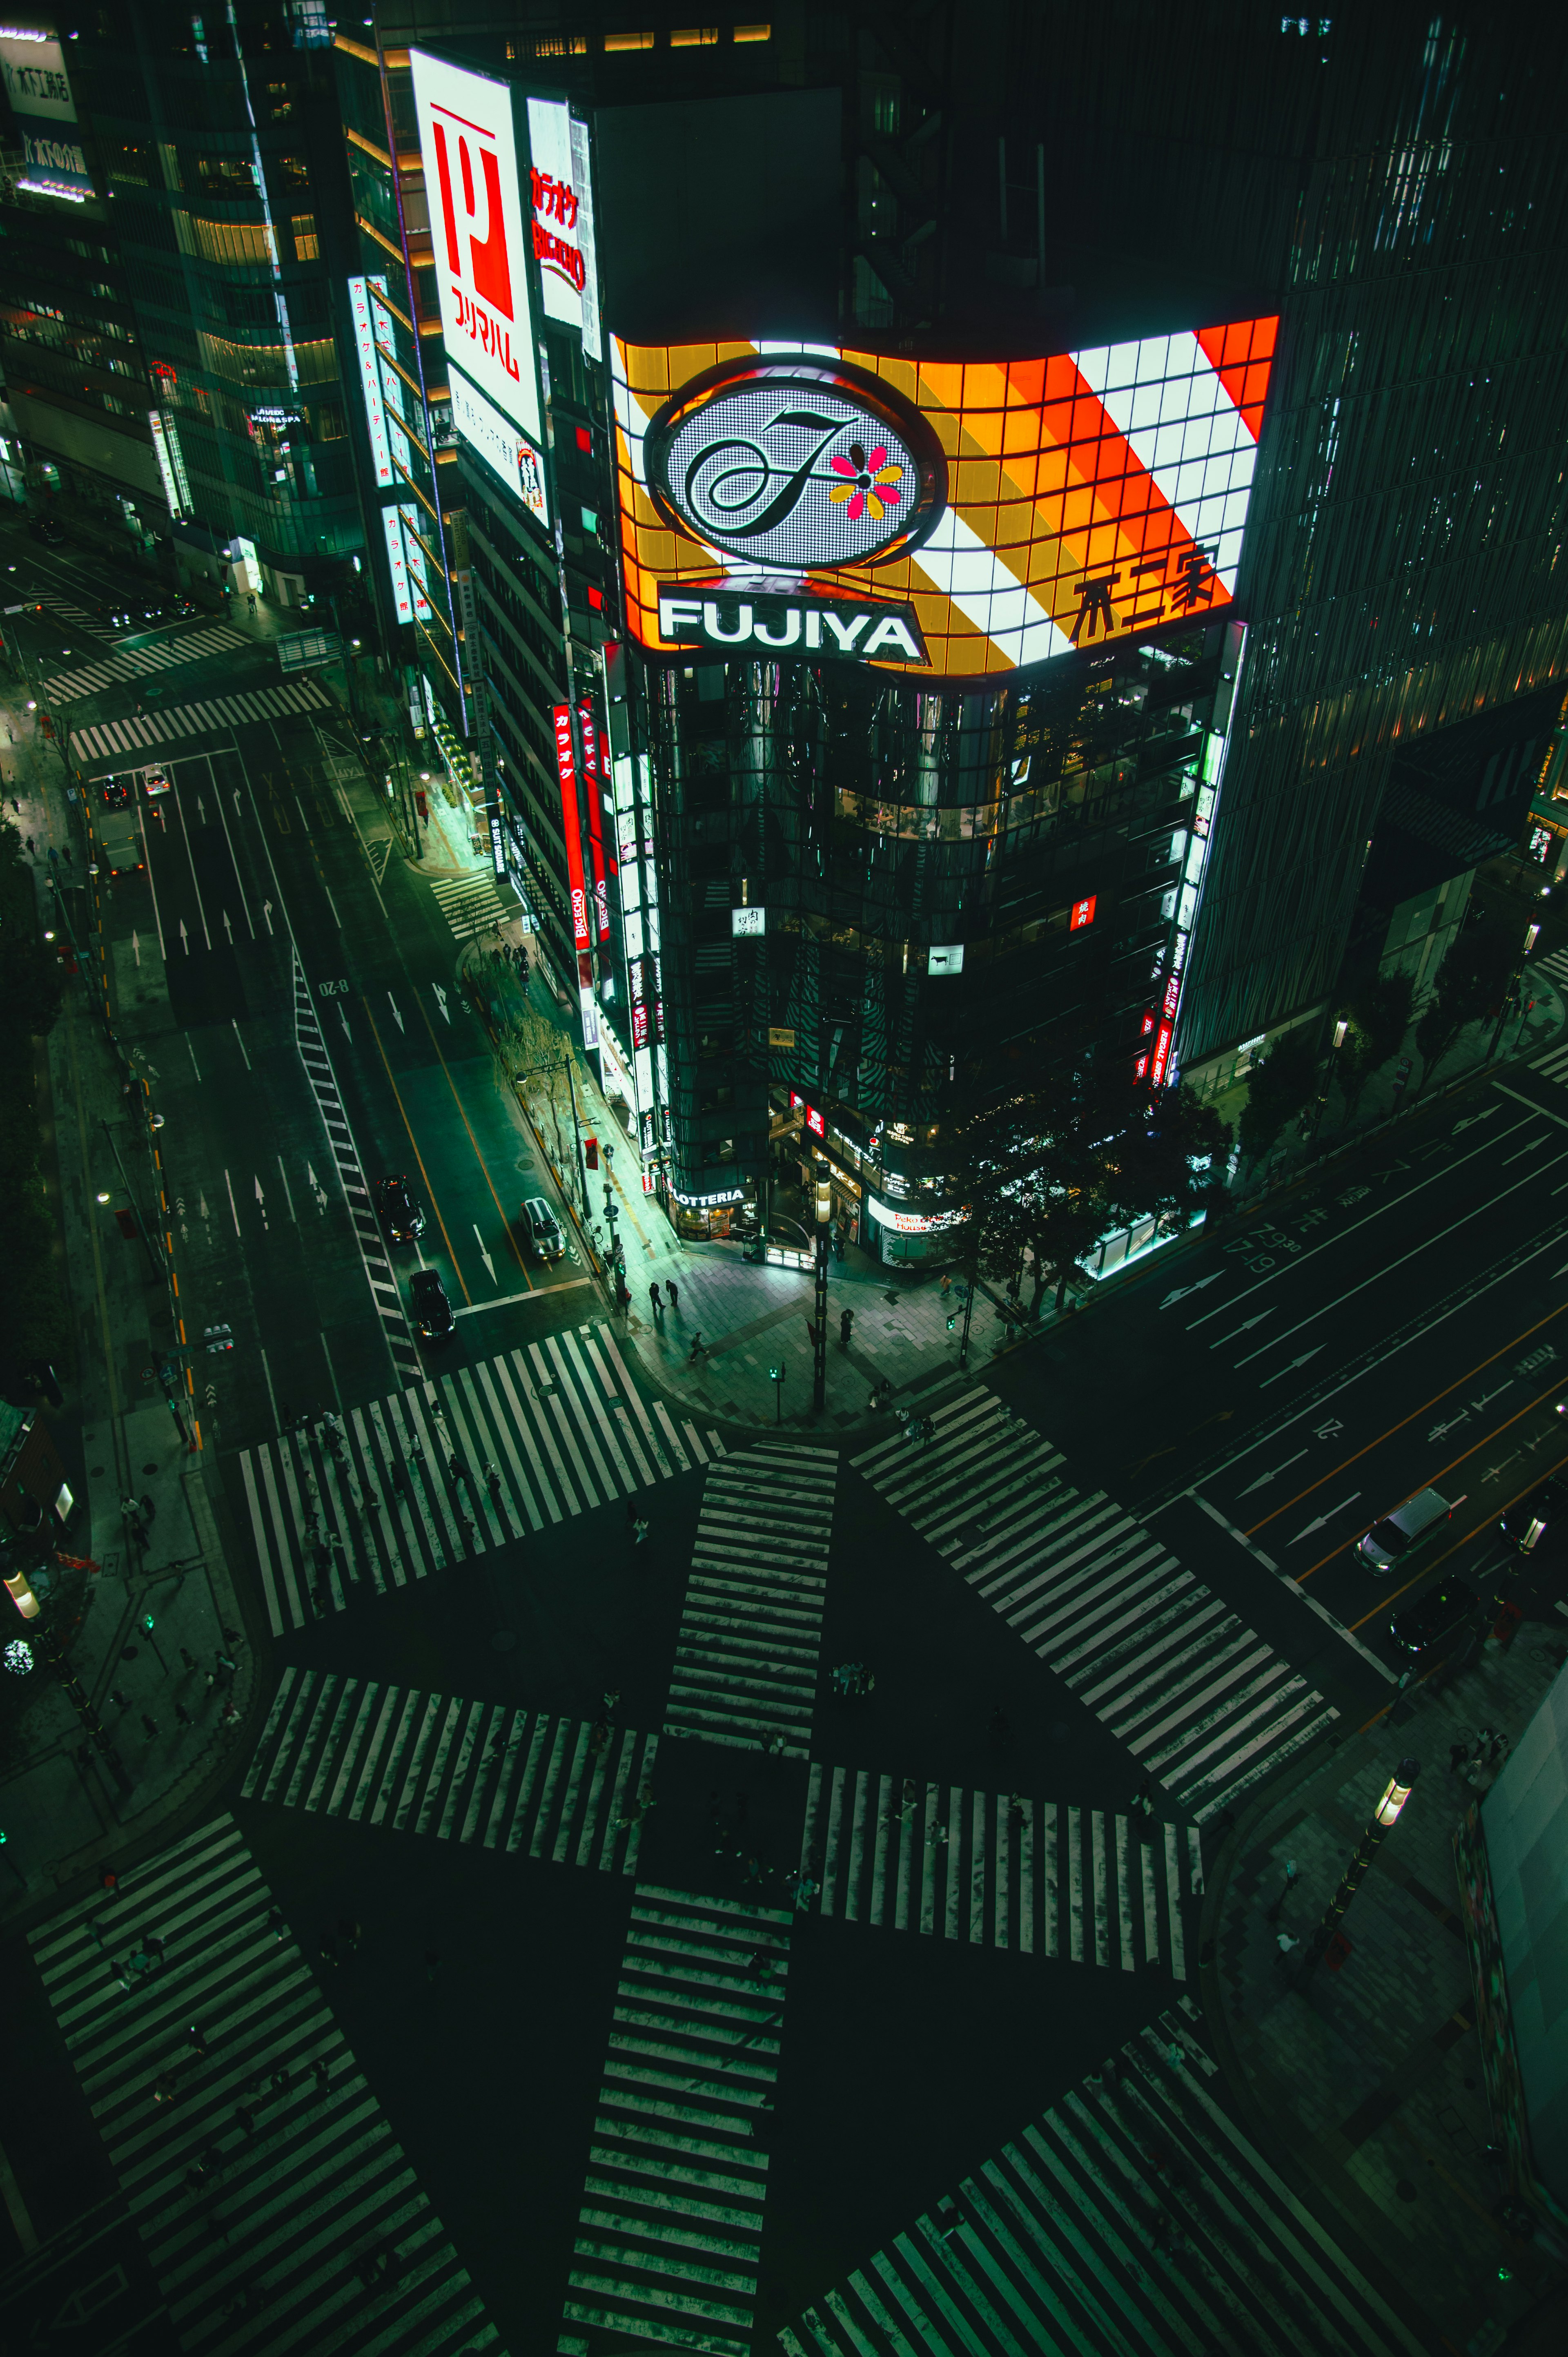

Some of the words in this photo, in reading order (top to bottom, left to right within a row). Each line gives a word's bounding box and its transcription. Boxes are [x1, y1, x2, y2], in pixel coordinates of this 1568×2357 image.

[530, 167, 576, 230] カラオケ
[532, 219, 554, 260] BIG
[554, 236, 583, 290] ECHO
[354, 283, 389, 477] カラオケ&パーティー館
[453, 518, 462, 558] BREITLING
[388, 519, 408, 611] カラオケ館
[1068, 542, 1217, 644] 不二家
[659, 599, 922, 658] FUJIYA
[557, 716, 573, 779] カラオケ
[492, 828, 501, 844] SUIT
[494, 844, 505, 873] SQUARE
[572, 889, 583, 919] ECHO
[748, 909, 758, 924] 肉の
[1078, 901, 1089, 925] 焼肉
[576, 919, 588, 939] BIG
[738, 916, 748, 935] 切り方
[319, 979, 350, 997] 8-20
[1156, 1030, 1168, 1059] REGAL
[1238, 1034, 1265, 1051] MIZUNO
[886, 1130, 902, 1138] HAND
[673, 1189, 744, 1206] LOTTERIA
[895, 1214, 918, 1223] Peko
[1222, 1238, 1275, 1273] 17-19
